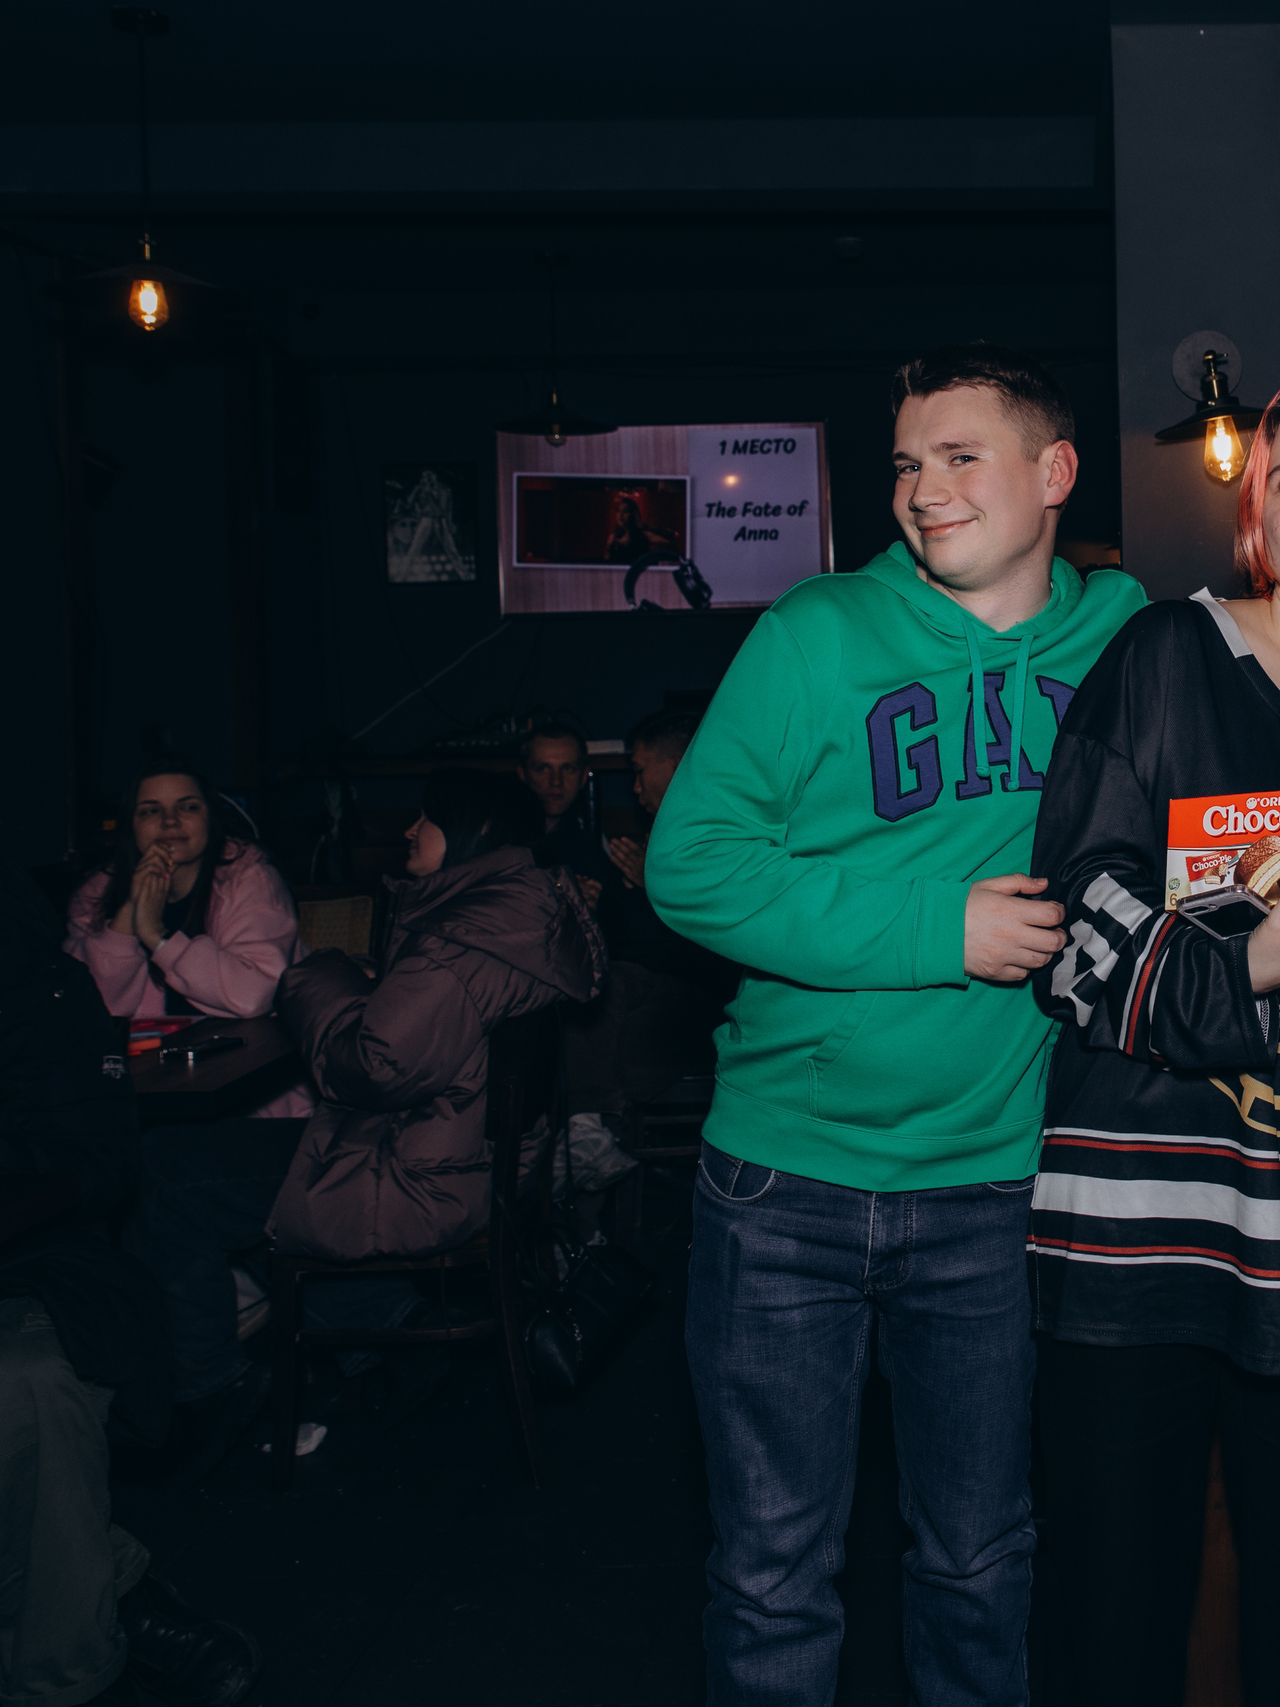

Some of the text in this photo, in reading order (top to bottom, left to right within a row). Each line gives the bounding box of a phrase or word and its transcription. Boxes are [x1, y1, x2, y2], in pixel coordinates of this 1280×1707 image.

[719, 438, 796, 455] 1 МЕСТО
[705, 500, 809, 518] The Fate of
[734, 526, 779, 541] Anna
